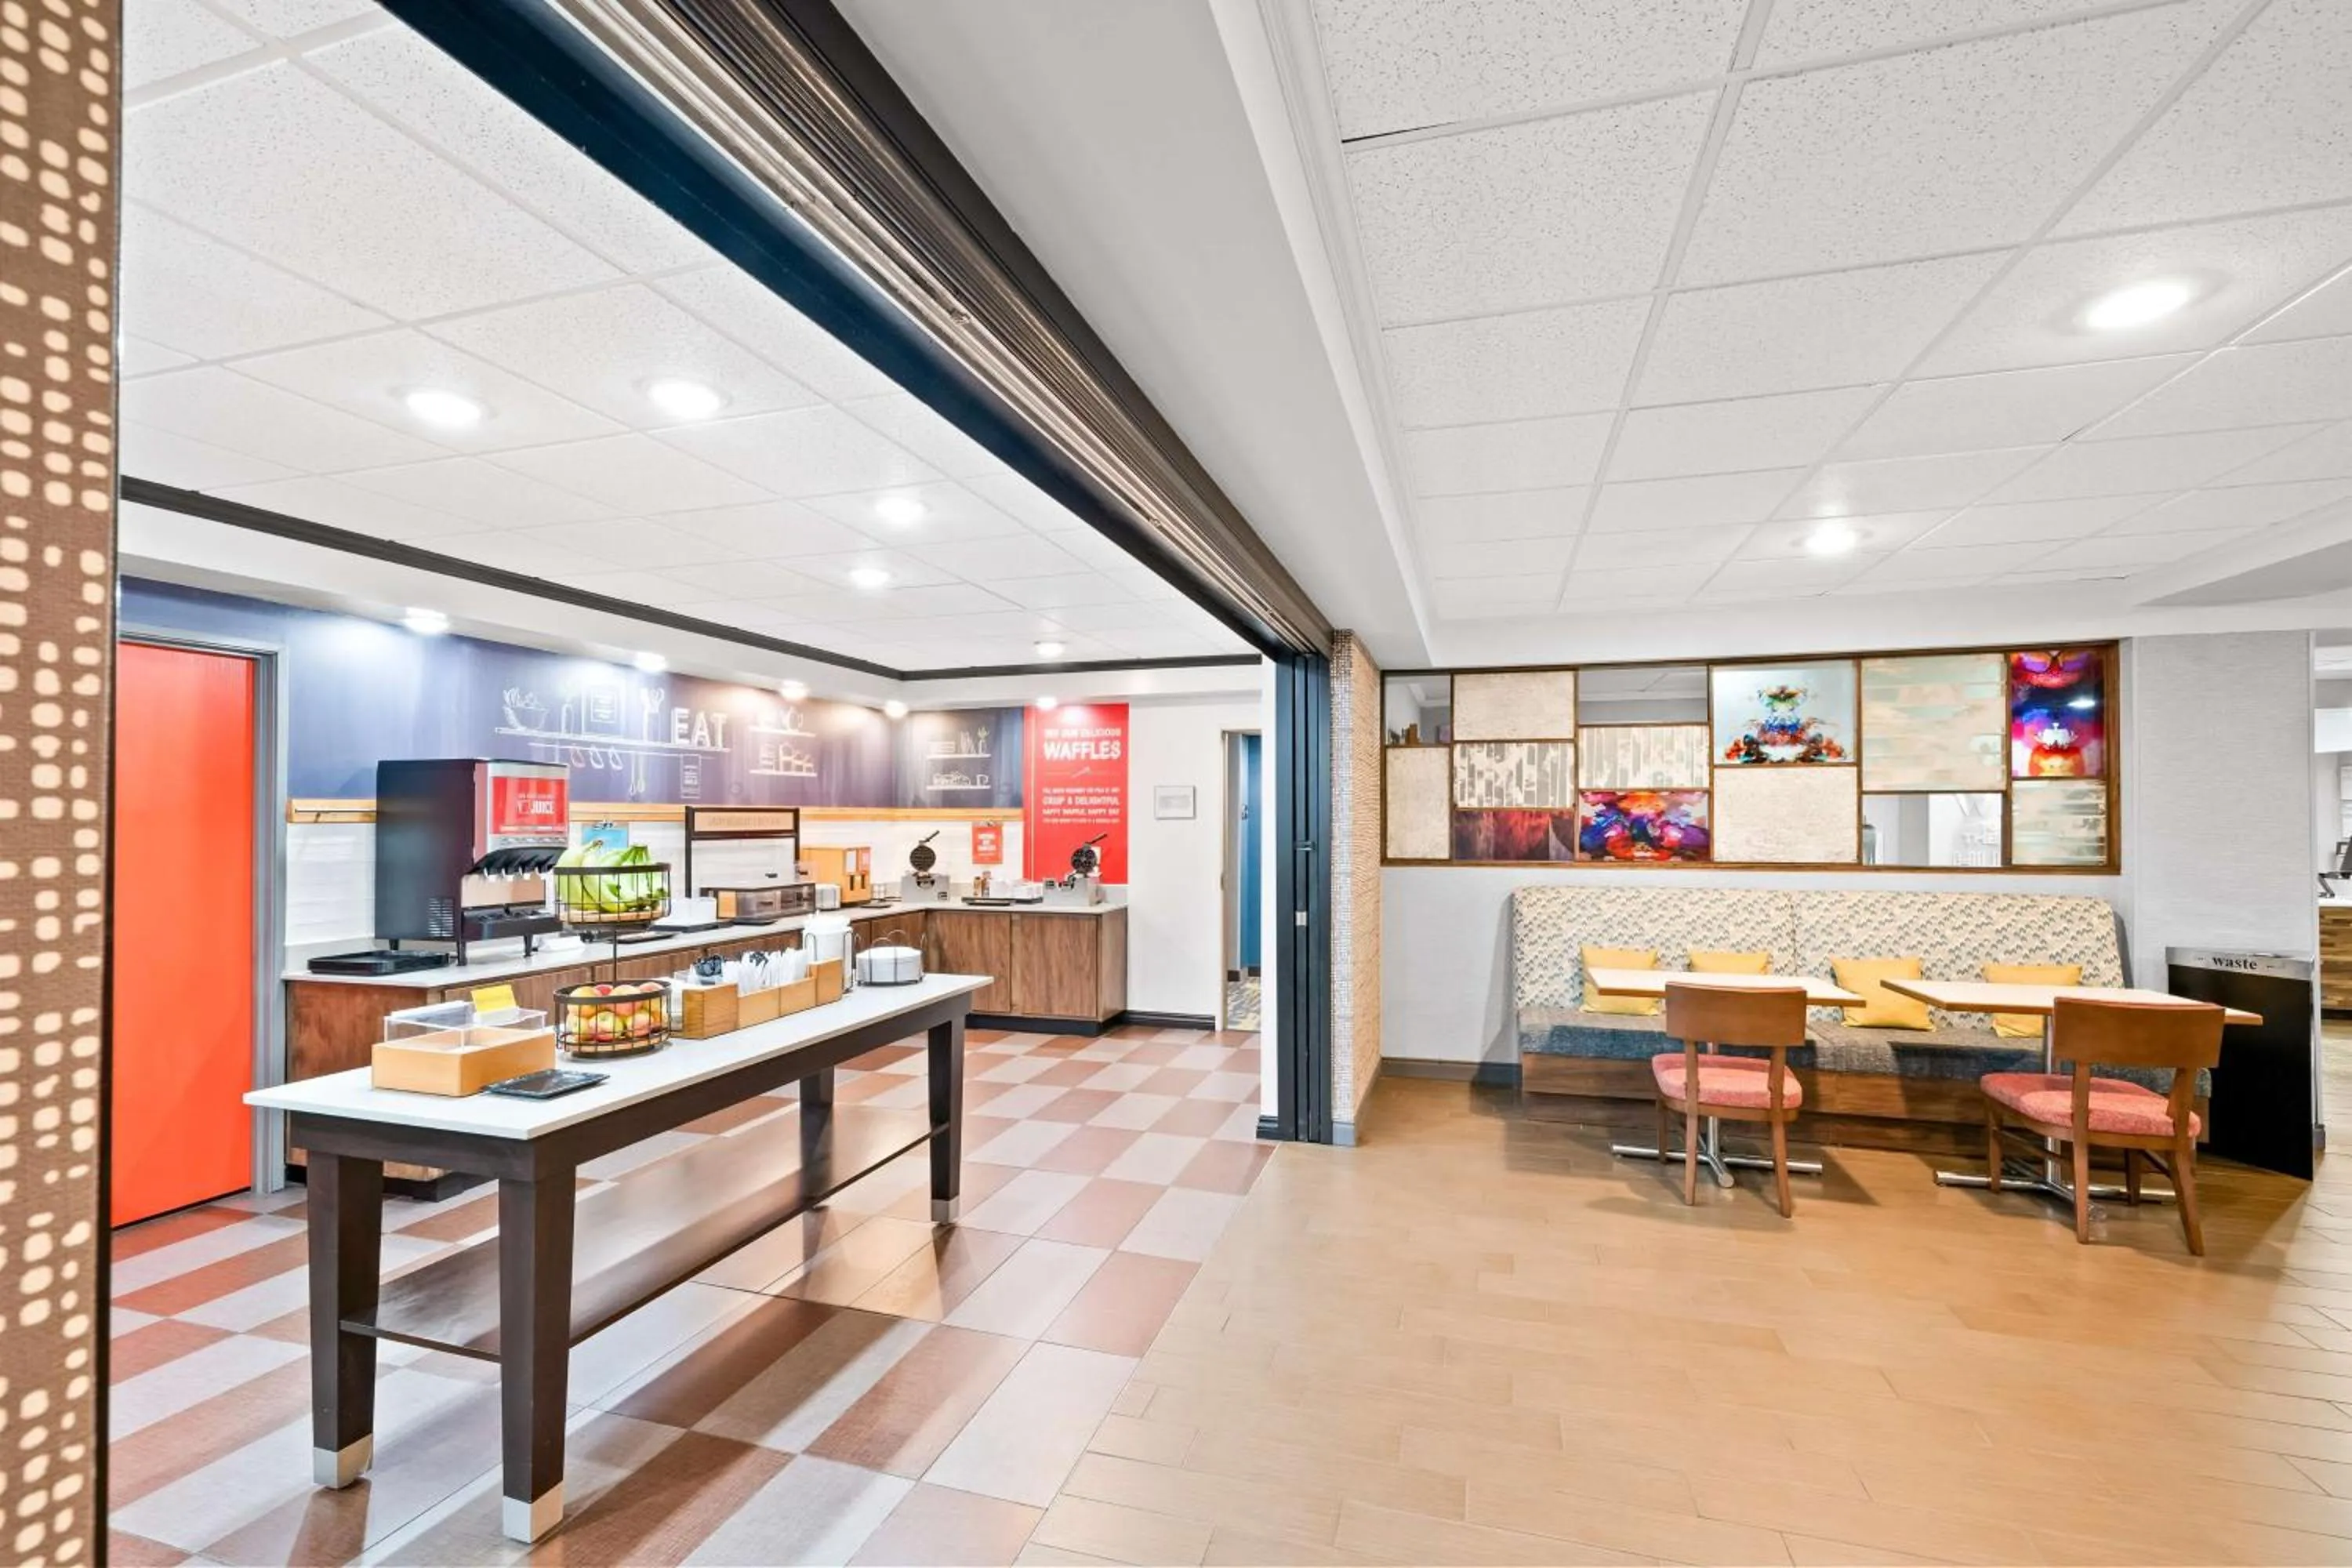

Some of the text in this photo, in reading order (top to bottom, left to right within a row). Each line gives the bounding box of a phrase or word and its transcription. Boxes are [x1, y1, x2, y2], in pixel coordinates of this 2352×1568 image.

[671, 707, 727, 749] EAT
[1044, 740, 1121, 760] WAFFLES
[530, 800, 555, 814] JUICE
[2212, 957, 2257, 970] waste
